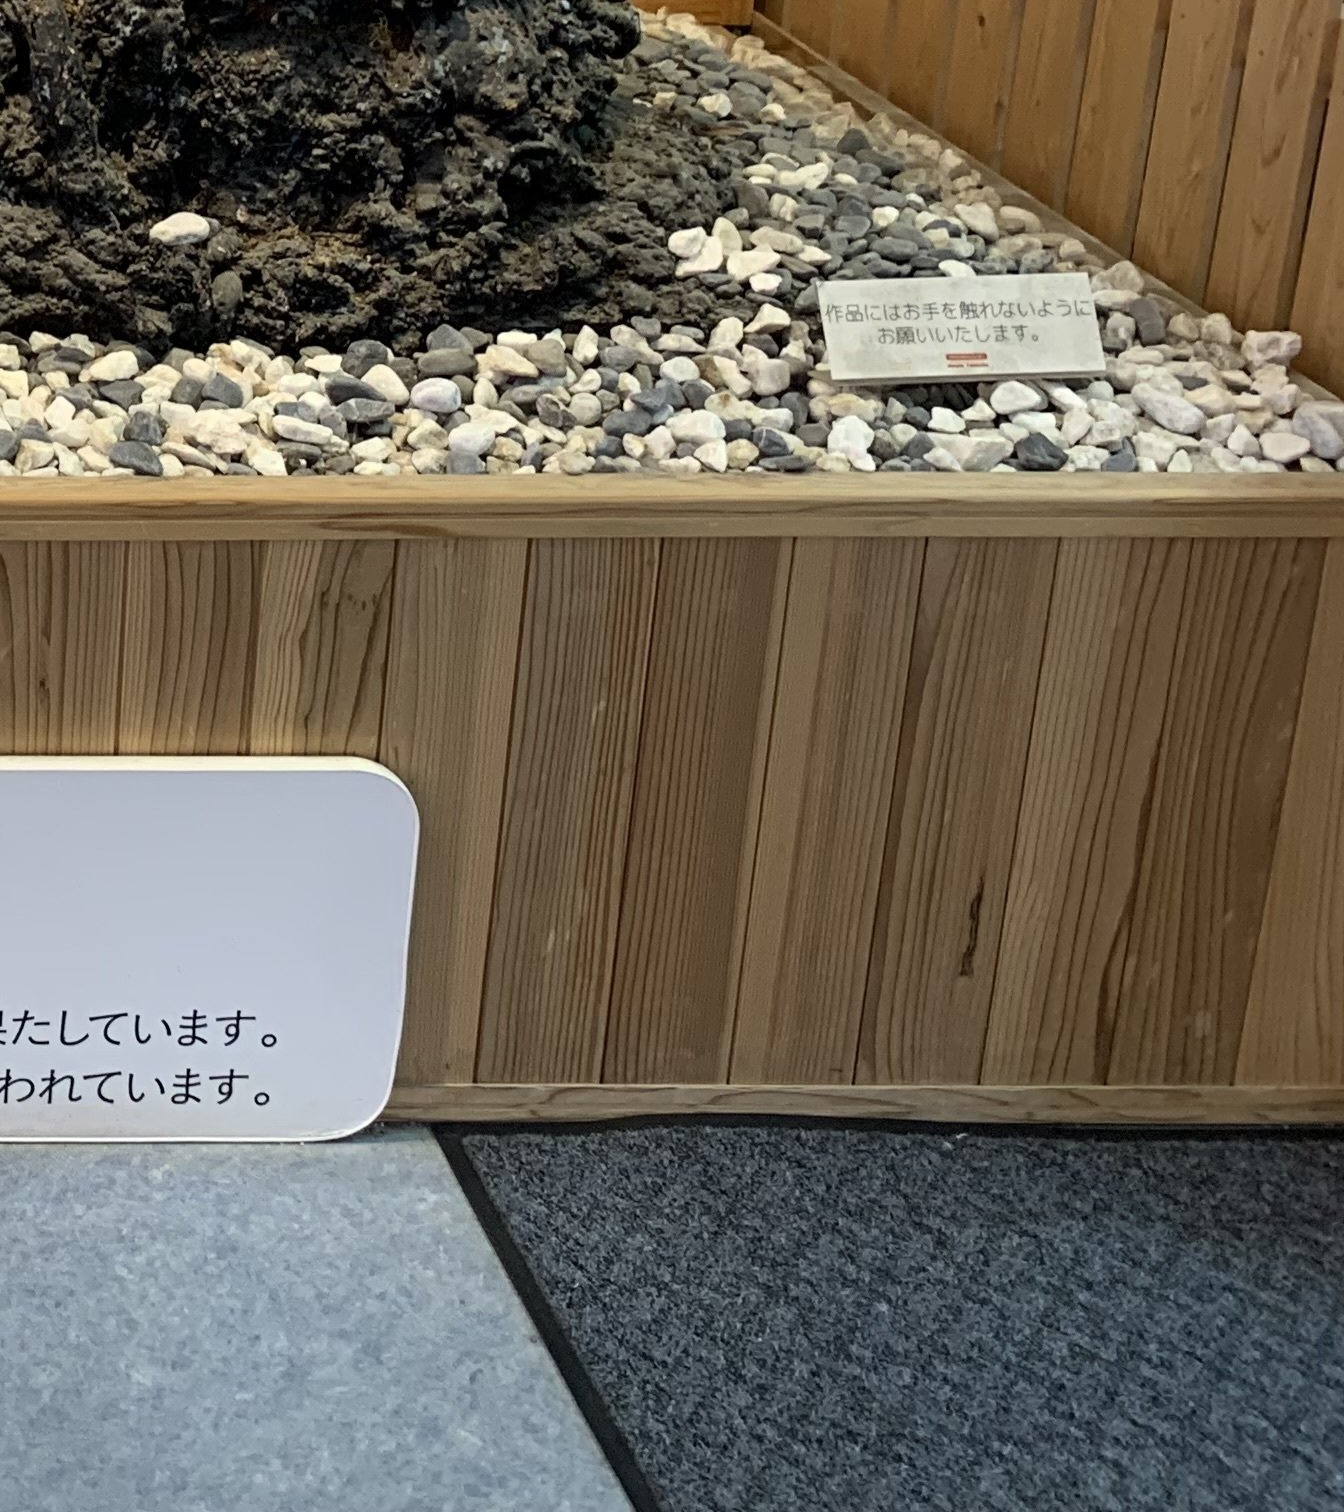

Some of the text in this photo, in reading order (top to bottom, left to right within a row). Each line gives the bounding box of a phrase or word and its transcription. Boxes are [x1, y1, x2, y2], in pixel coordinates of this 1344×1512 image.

[825, 298, 1091, 324] 作品にはお手を触れないように
[877, 324, 1040, 346] お願いいたします。
